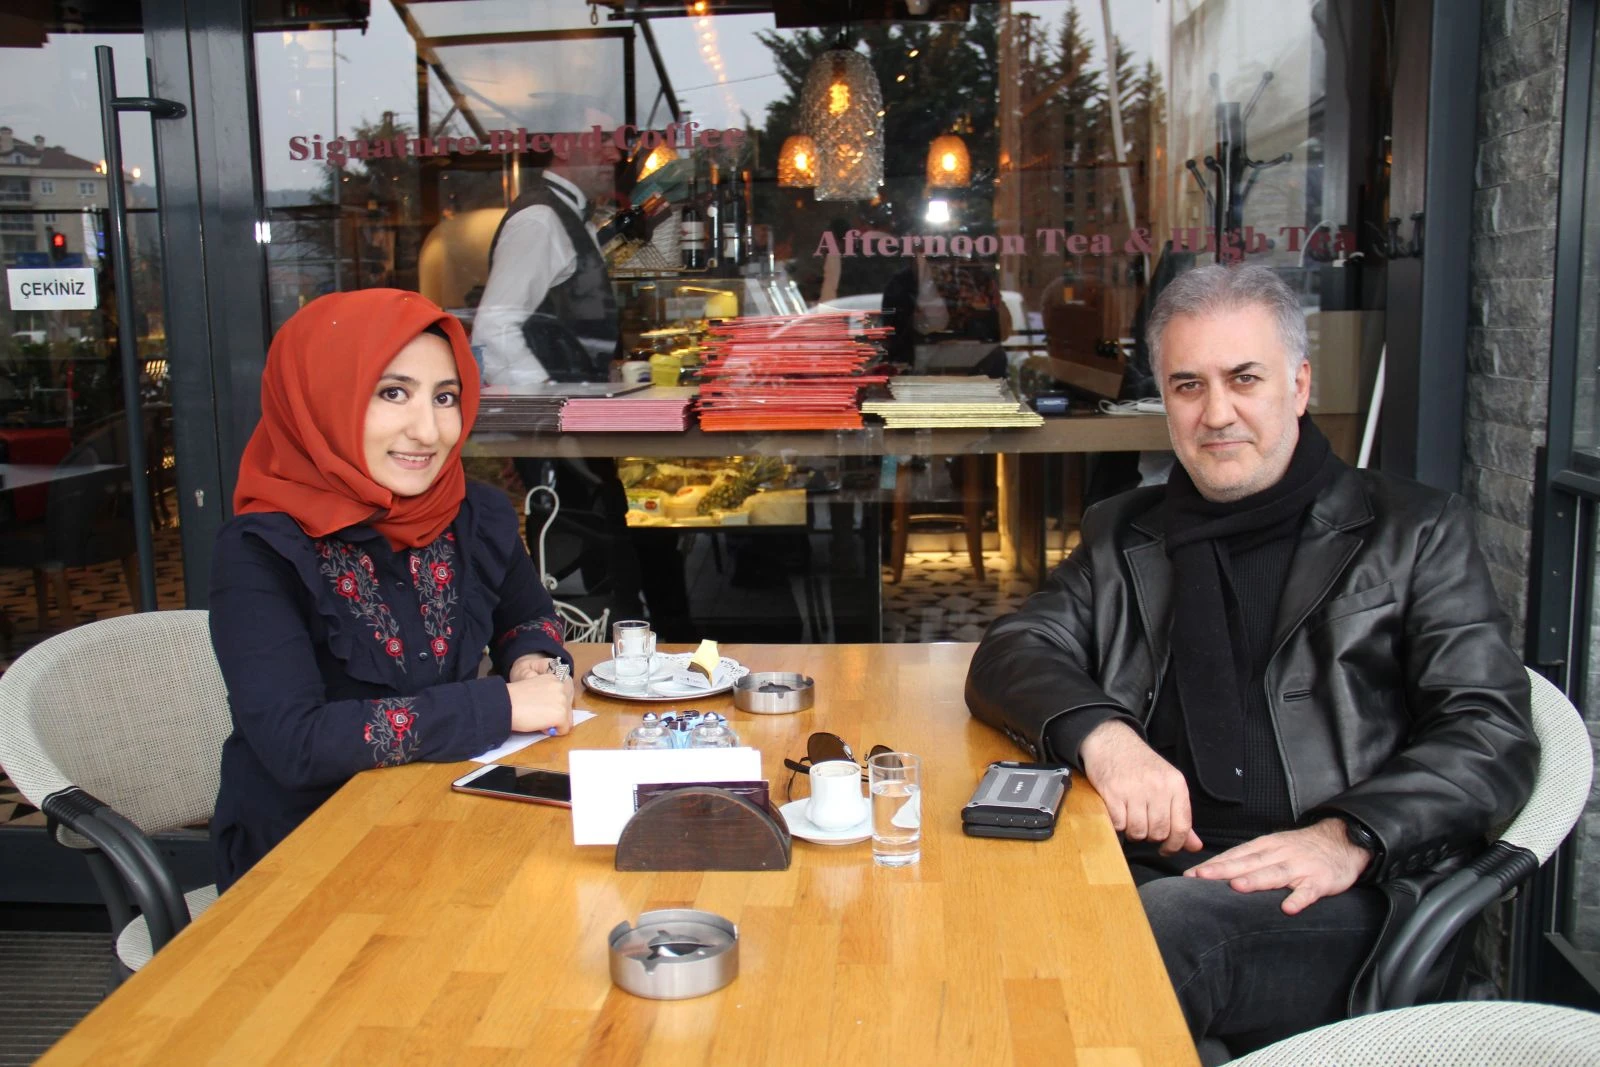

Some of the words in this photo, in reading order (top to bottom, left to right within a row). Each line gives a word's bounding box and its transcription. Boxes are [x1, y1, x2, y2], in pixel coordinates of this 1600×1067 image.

[289, 133, 477, 167] Signature
[488, 124, 602, 155] Blend
[613, 121, 746, 151] Coffee
[813, 229, 1026, 258] Afternoon
[1036, 228, 1112, 257] Tea
[1124, 227, 1153, 256] &
[1171, 226, 1268, 268] High
[1280, 226, 1357, 256] Tea
[20, 279, 86, 299] ÇEKİNİZ
